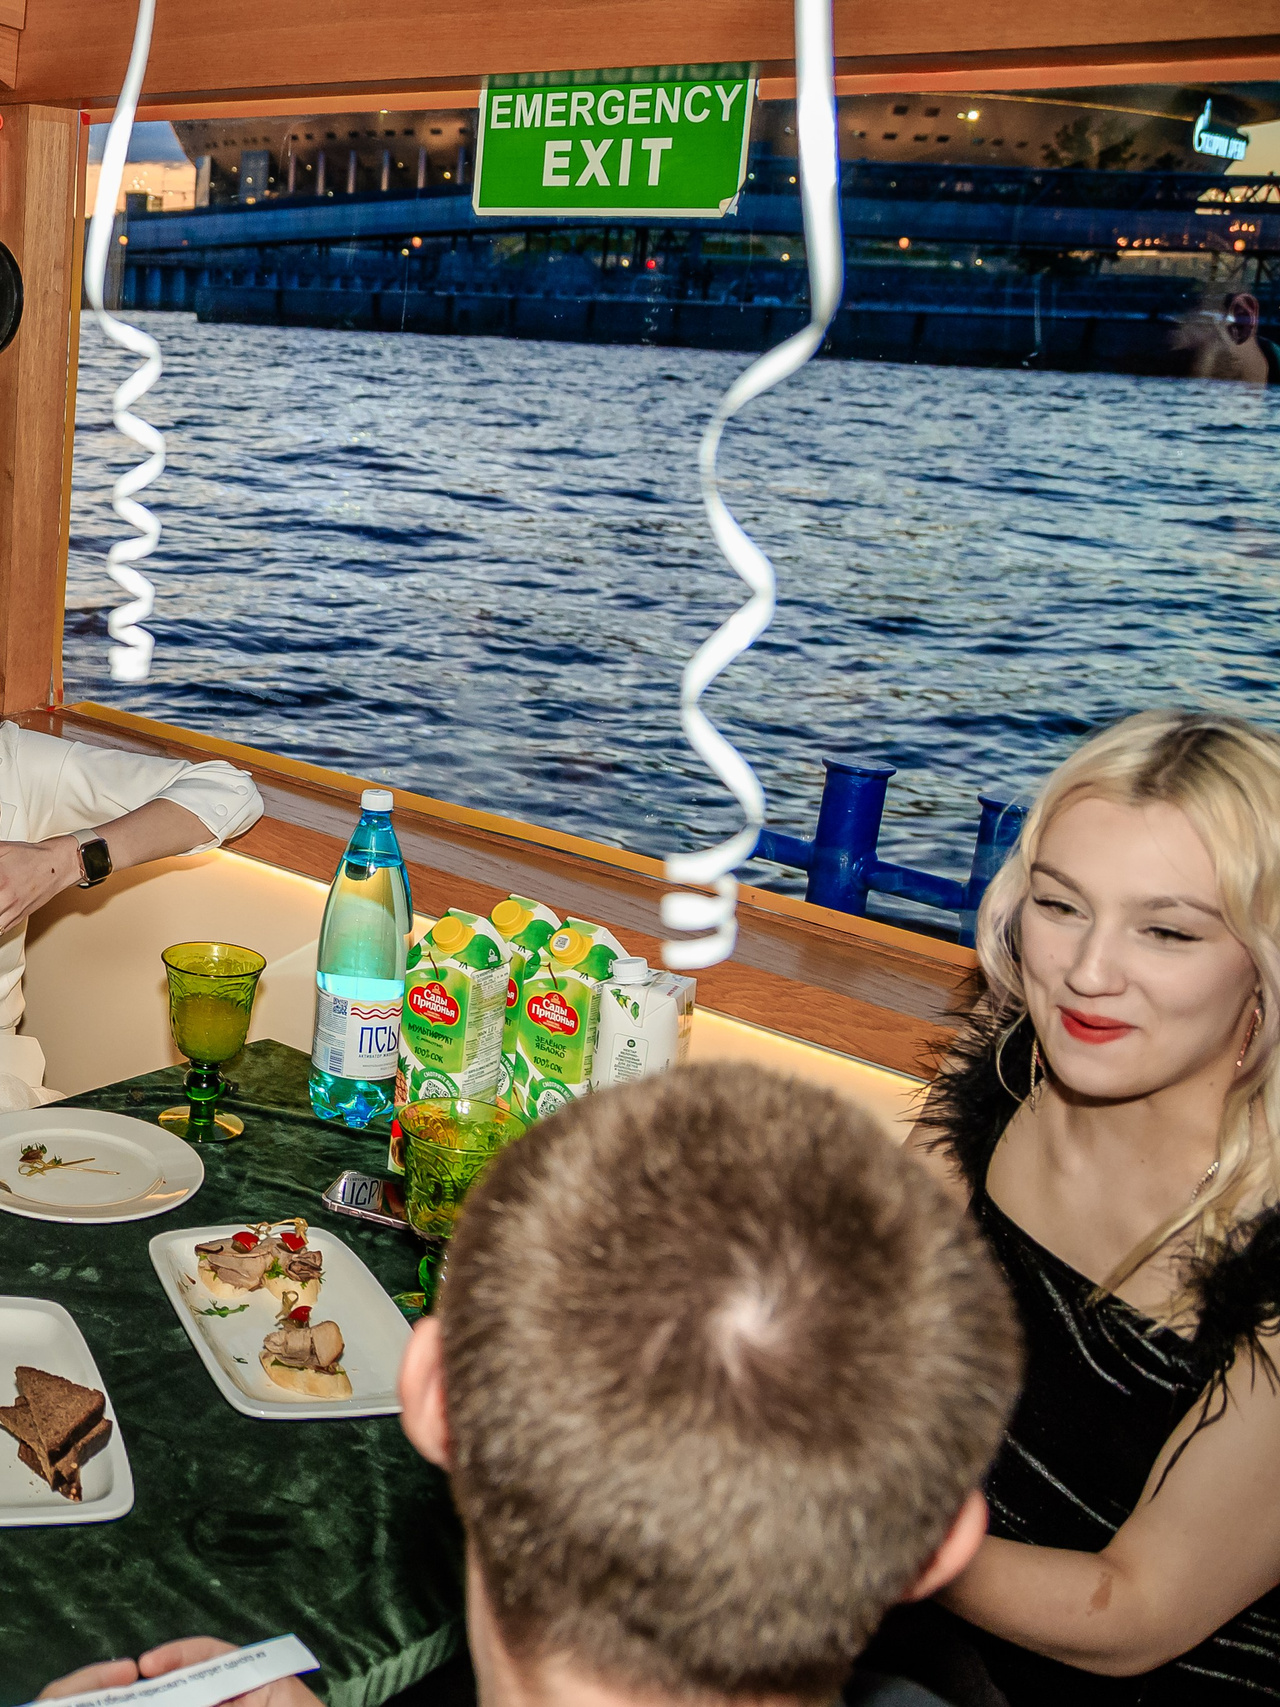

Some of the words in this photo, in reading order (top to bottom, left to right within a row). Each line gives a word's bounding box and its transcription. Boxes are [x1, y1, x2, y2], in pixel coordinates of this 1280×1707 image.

[490, 84, 744, 129] EMERGENCY
[542, 137, 673, 187] EXIT
[413, 994, 456, 1018] Придонья
[423, 989, 448, 1006] Сады
[542, 998, 568, 1016] Сады
[531, 1003, 575, 1028] Придонья
[408, 1022, 453, 1045] МУЛЬТИФРУКТ
[414, 1046, 430, 1059] 100%
[535, 1042, 565, 1059] ЯБЛОКО
[533, 1056, 549, 1068] 100%
